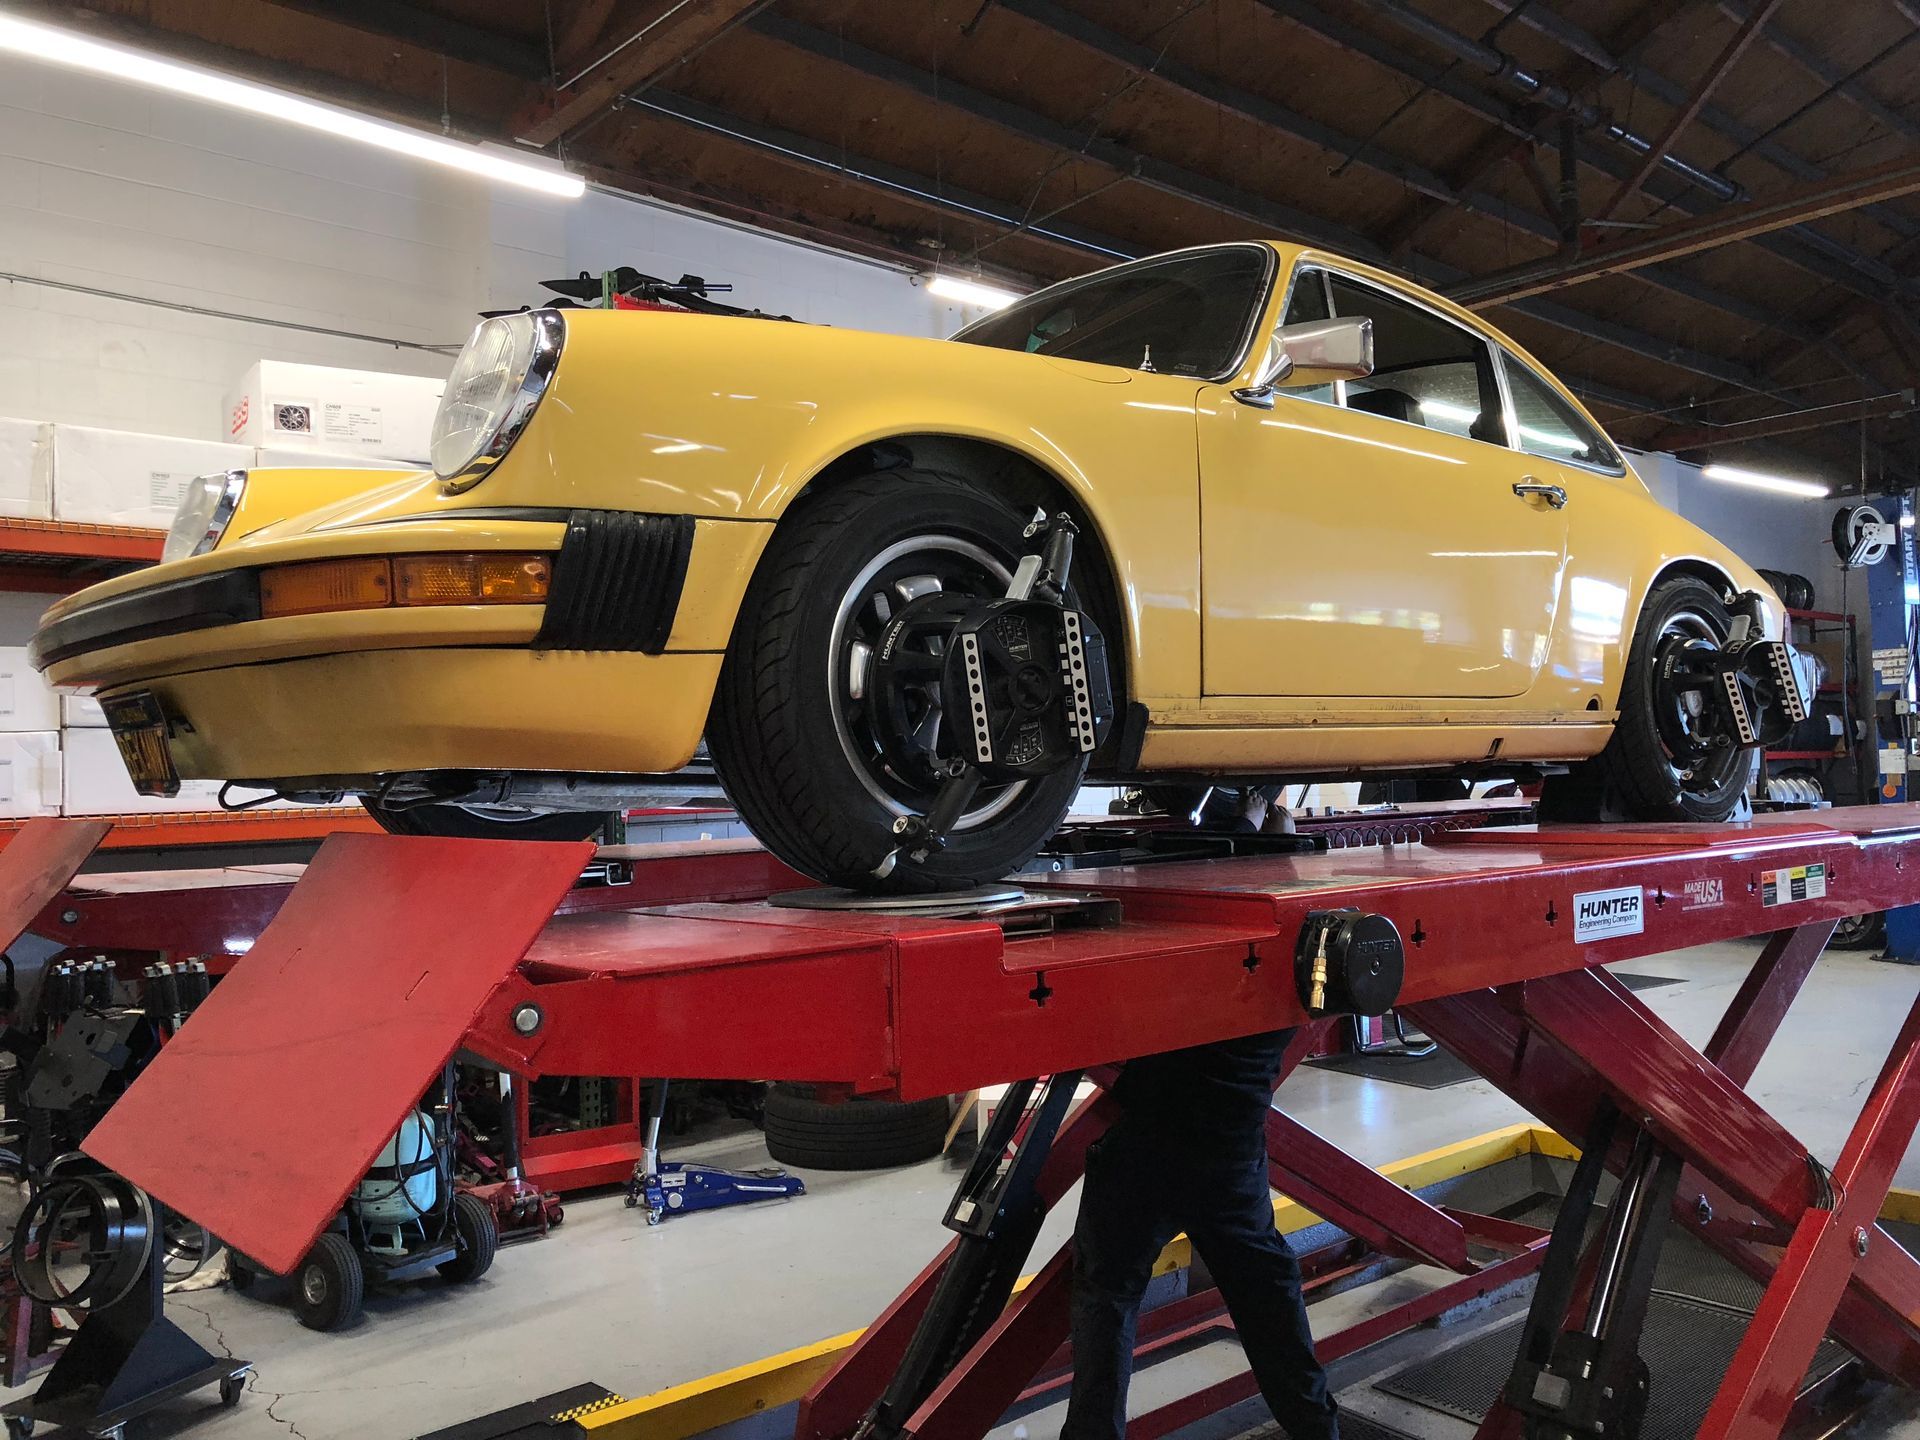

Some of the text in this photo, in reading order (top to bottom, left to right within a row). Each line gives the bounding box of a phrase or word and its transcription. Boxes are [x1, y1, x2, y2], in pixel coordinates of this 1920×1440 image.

[1904, 532, 1914, 580] OTARY
[882, 620, 906, 660] HUNTER
[1684, 881, 1701, 894] MADE
[1701, 879, 1723, 903] USA
[1580, 896, 1639, 919] HUNTER
[1694, 893, 1701, 904] IN
[1579, 914, 1637, 929] Engineering Company
[1357, 939, 1396, 953] HUNTER
